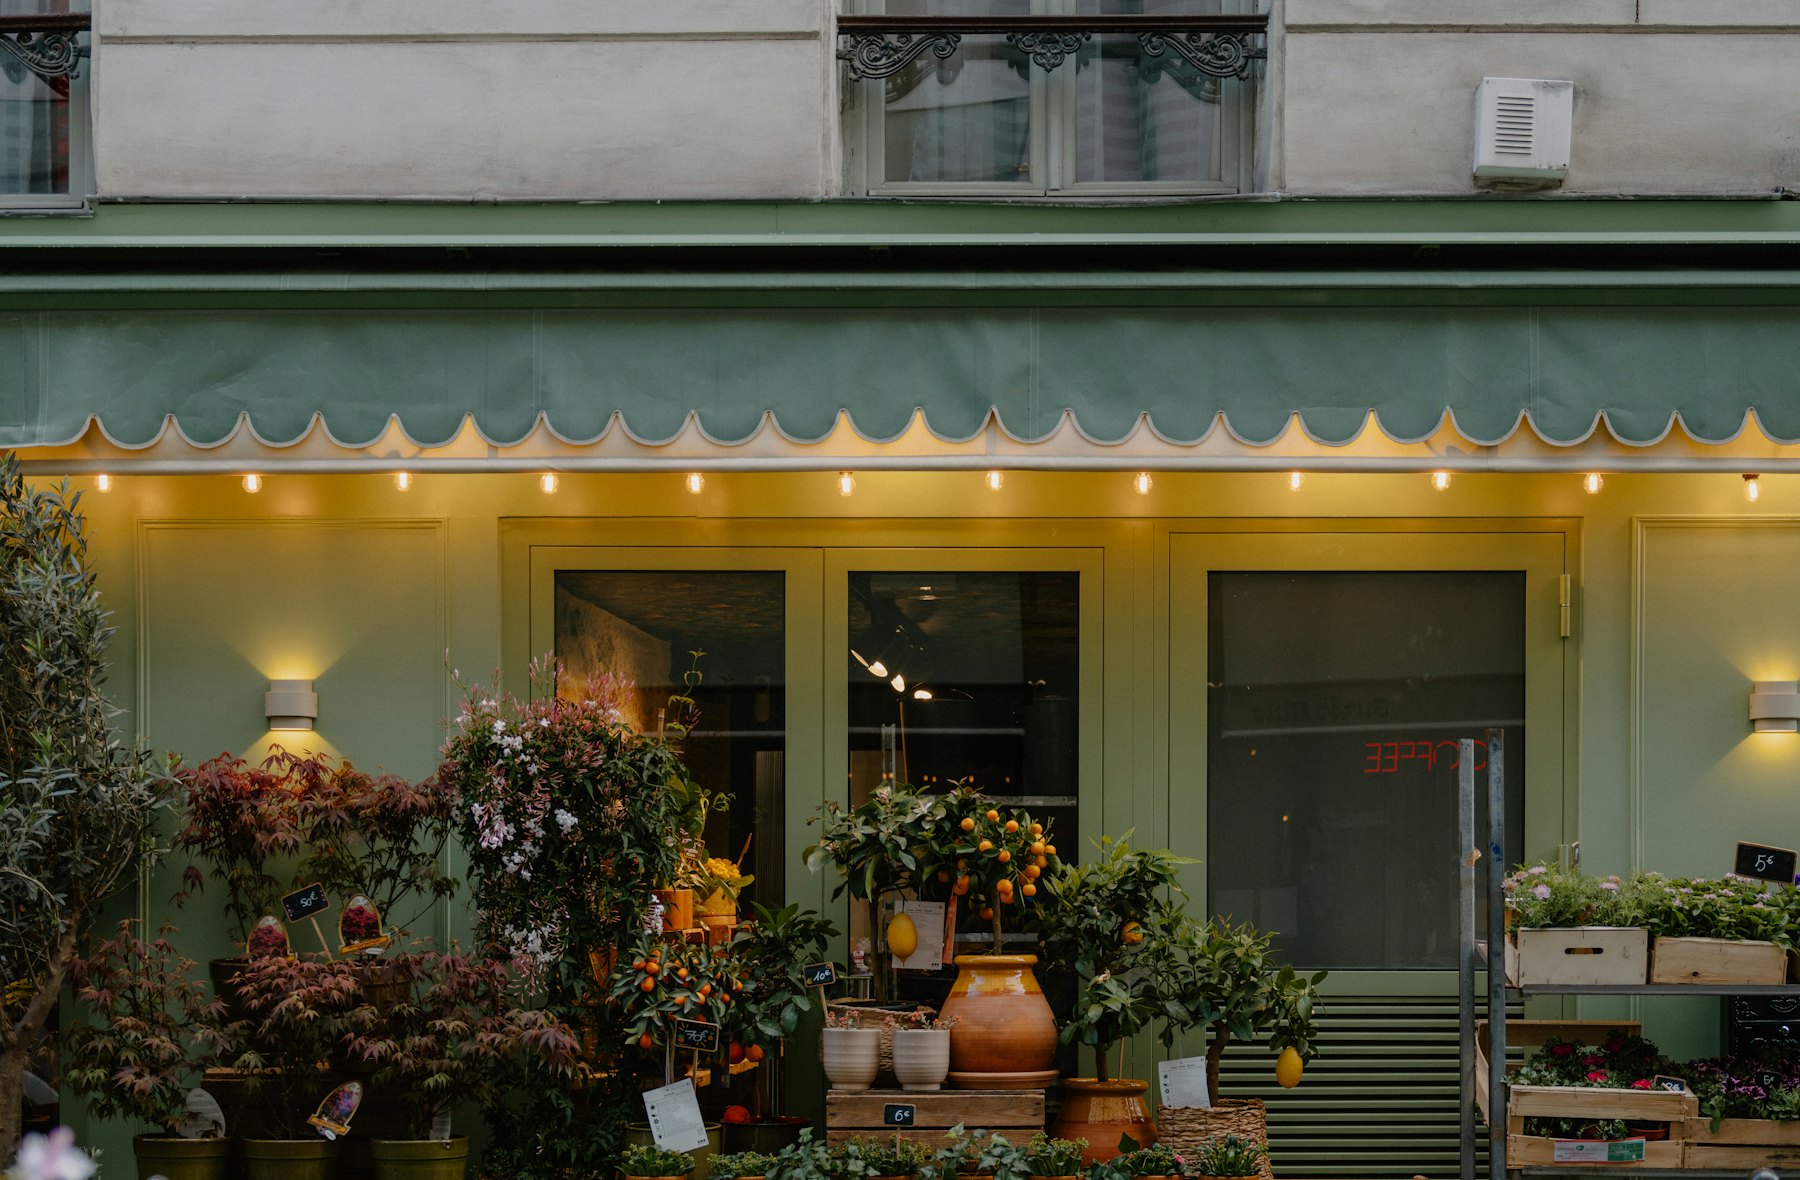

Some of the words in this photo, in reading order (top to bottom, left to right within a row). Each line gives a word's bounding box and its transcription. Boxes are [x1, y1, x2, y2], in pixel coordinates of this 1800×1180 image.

[1754, 854, 1774, 872] 5€
[301, 891, 319, 908] 50€
[813, 969, 831, 981] 10€
[685, 1030, 708, 1042] 70€
[894, 1109, 911, 1122] 6€
